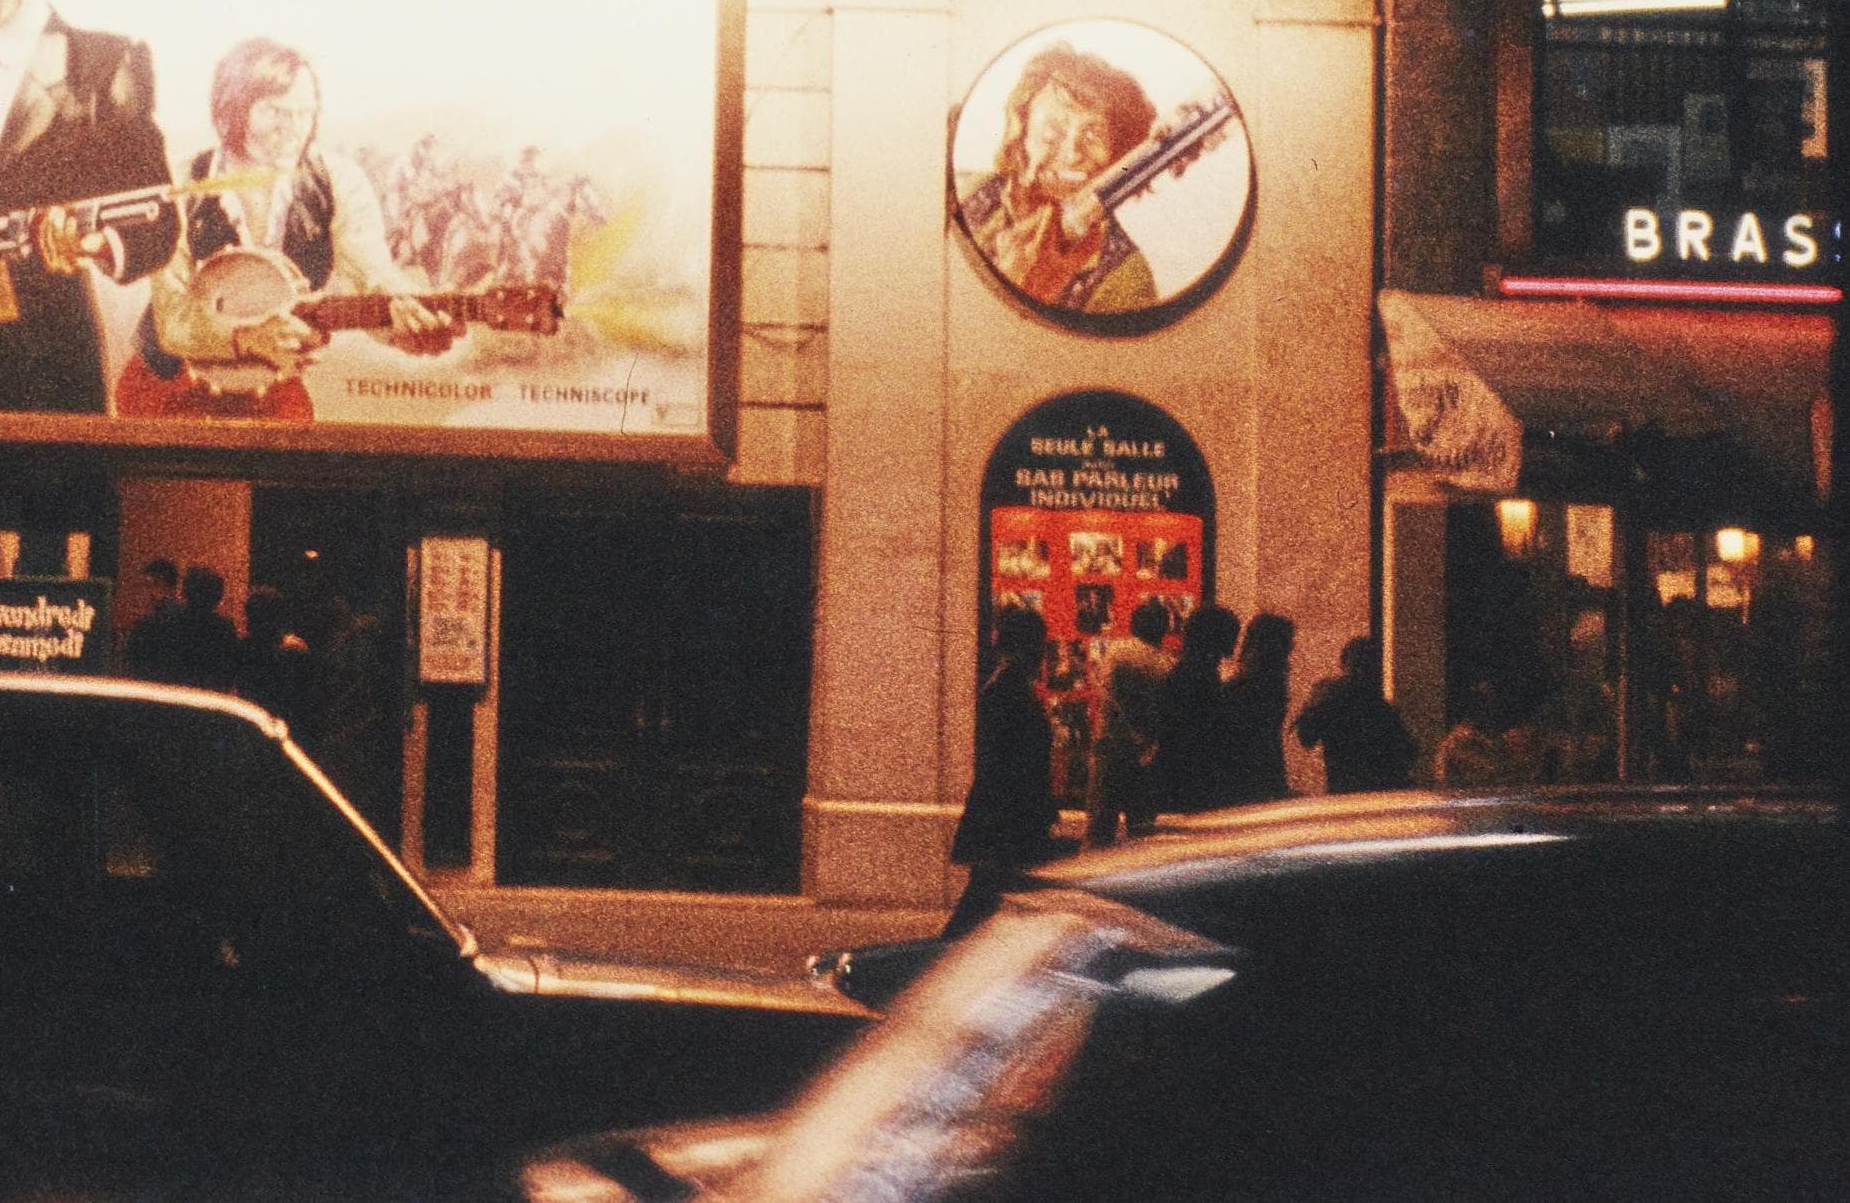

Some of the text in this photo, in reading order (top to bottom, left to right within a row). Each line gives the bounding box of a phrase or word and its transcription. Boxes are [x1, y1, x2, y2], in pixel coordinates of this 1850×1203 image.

[346, 378, 651, 406] TECHNICOLOR TECHNISCOPE
[1030, 436, 1094, 457] SEULE
